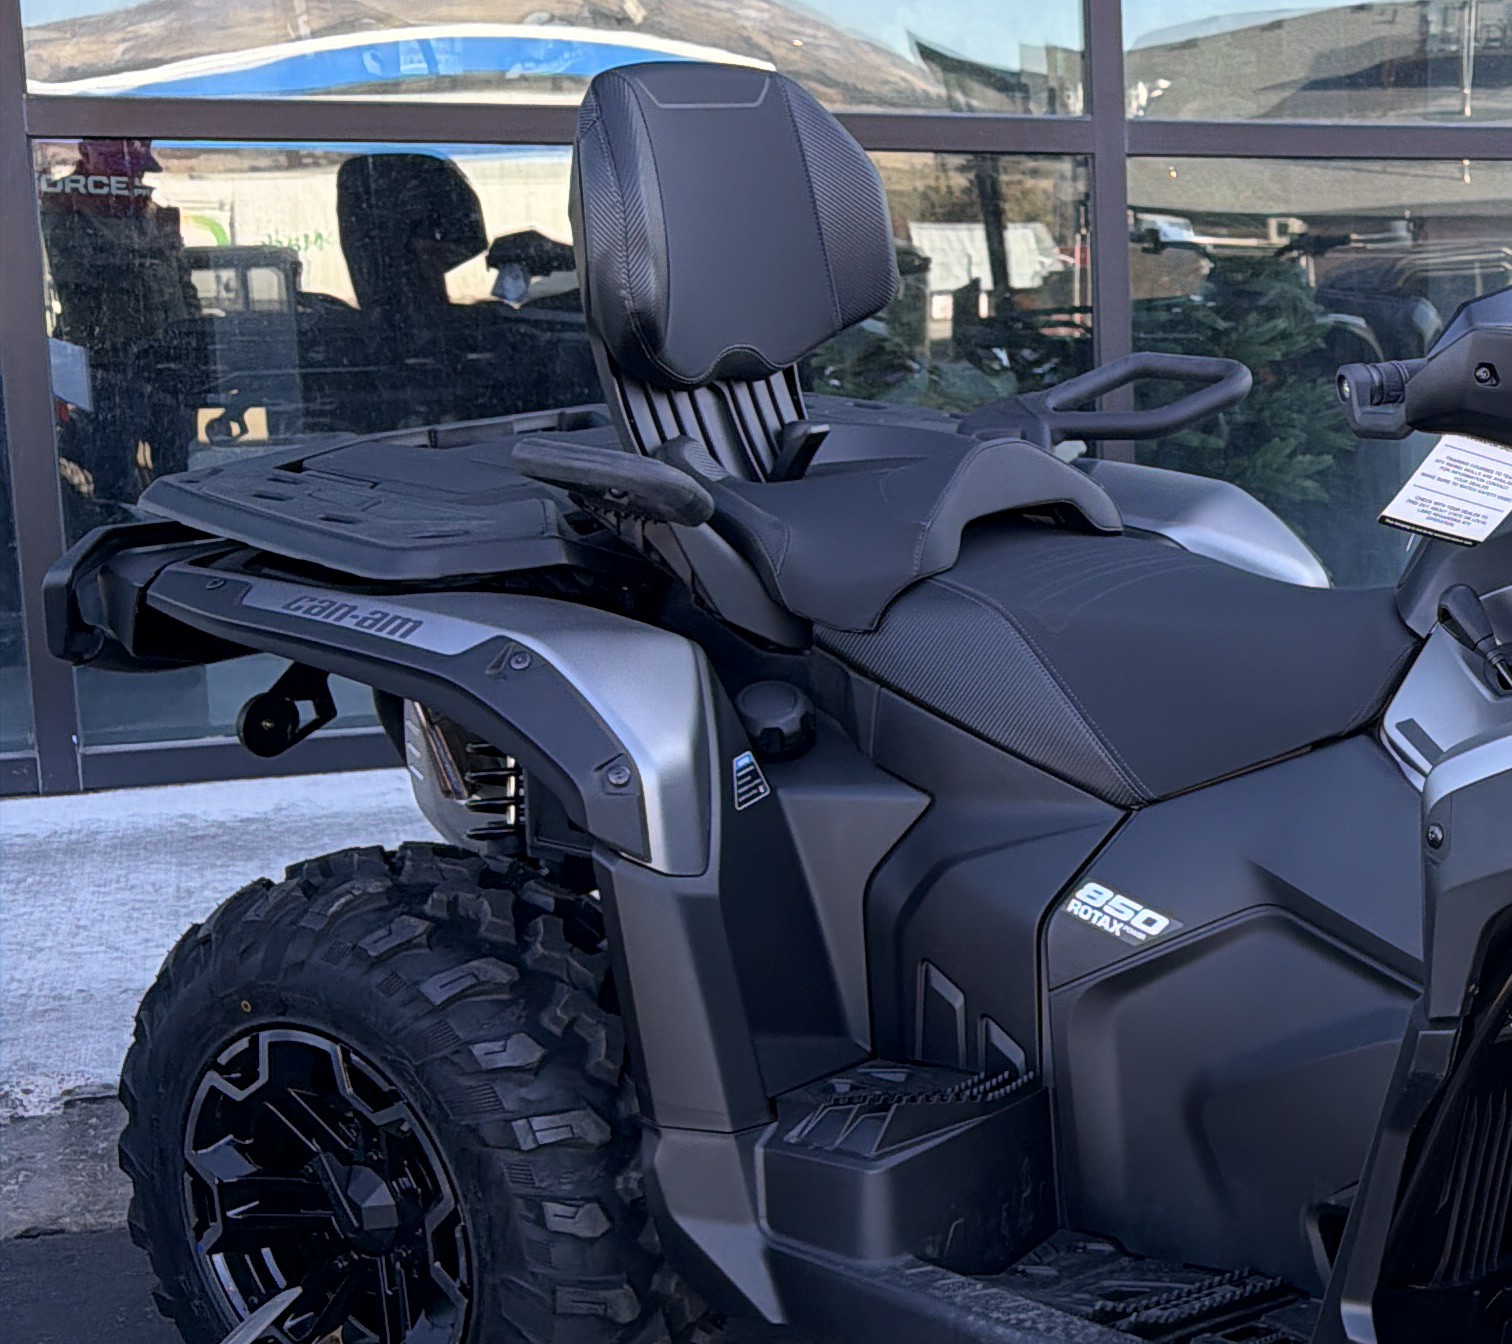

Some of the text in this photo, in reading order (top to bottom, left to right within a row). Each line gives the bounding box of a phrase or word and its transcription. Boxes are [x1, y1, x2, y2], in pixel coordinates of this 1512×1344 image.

[282, 594, 424, 639] can-am
[1066, 898, 1124, 937] ROTAX
[1075, 882, 1170, 936] 850
